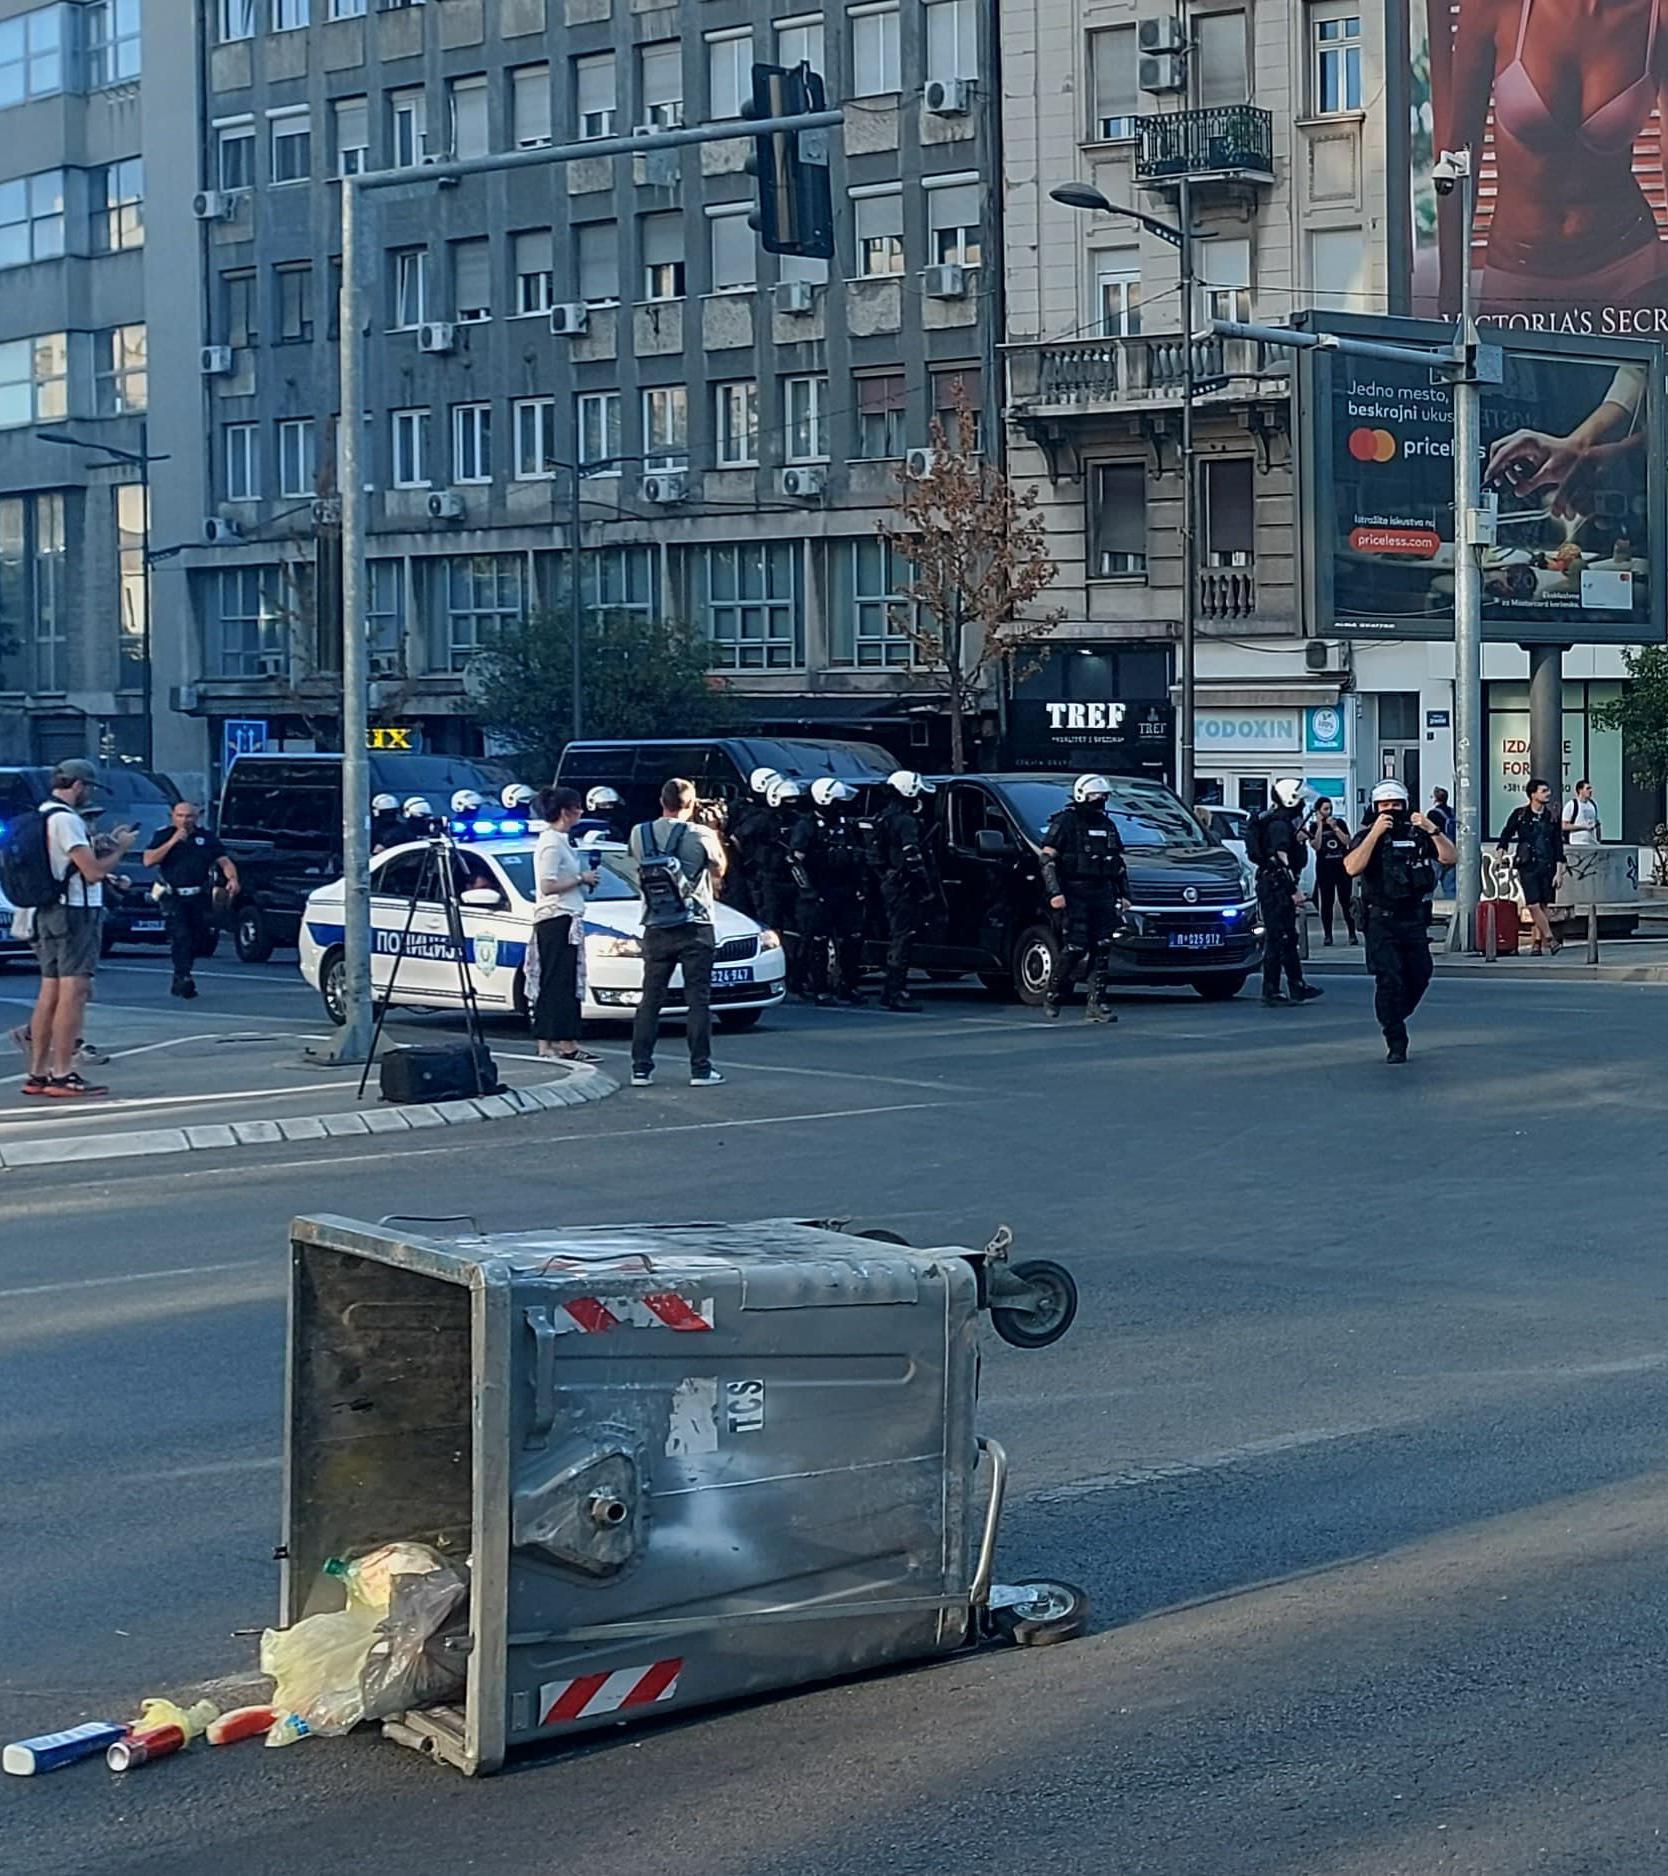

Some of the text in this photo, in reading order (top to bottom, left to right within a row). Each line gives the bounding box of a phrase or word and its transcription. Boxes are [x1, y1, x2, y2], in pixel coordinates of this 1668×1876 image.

[1347, 380, 1449, 404] Jedno mesto,
[1348, 400, 1417, 423] beskrajni
[1404, 436, 1487, 459] pricels
[1358, 533, 1433, 548] priceless.com
[1046, 702, 1126, 729] TREF
[376, 930, 463, 960] ПОЛИЦИЈ
[727, 1381, 762, 1433] TCS
